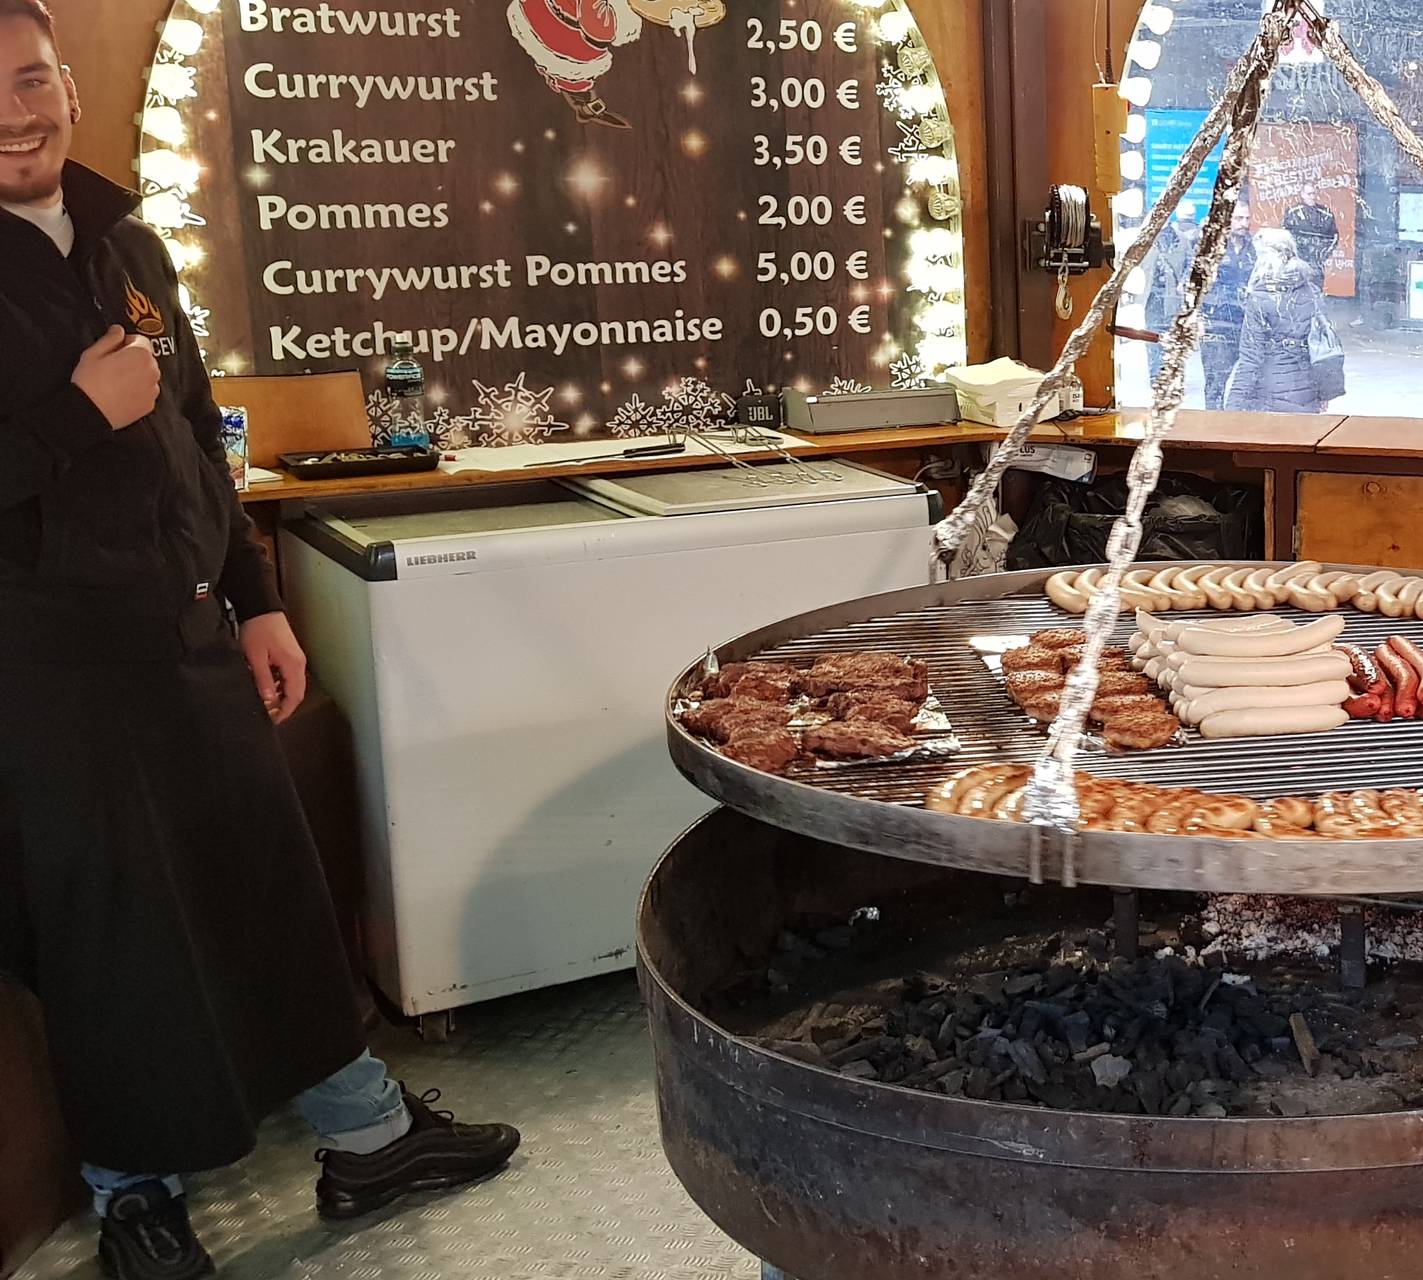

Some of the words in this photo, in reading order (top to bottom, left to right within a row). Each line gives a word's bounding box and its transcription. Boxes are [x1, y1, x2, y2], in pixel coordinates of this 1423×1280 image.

[239, 0, 462, 38] Bratwurst
[745, 17, 823, 55] 2,50
[833, 21, 858, 53] €
[243, 62, 499, 109] Currywurst
[750, 76, 826, 113] 3,00
[836, 79, 860, 110] €
[250, 128, 456, 164] Krakauer
[753, 134, 828, 170] 3,50
[839, 135, 863, 166] €
[256, 194, 449, 231] Pommes
[757, 194, 833, 230] 2,00
[843, 195, 867, 226] €
[261, 257, 512, 300] Currywurst
[525, 253, 688, 287] Pommes
[756, 250, 836, 286] 5,00
[845, 250, 869, 280] €
[269, 308, 724, 363] Ketchup/Mayonnaise
[758, 305, 838, 341] 0,50
[848, 304, 872, 334] €
[747, 406, 774, 422] JBL
[406, 550, 477, 567] LIEBHERR
